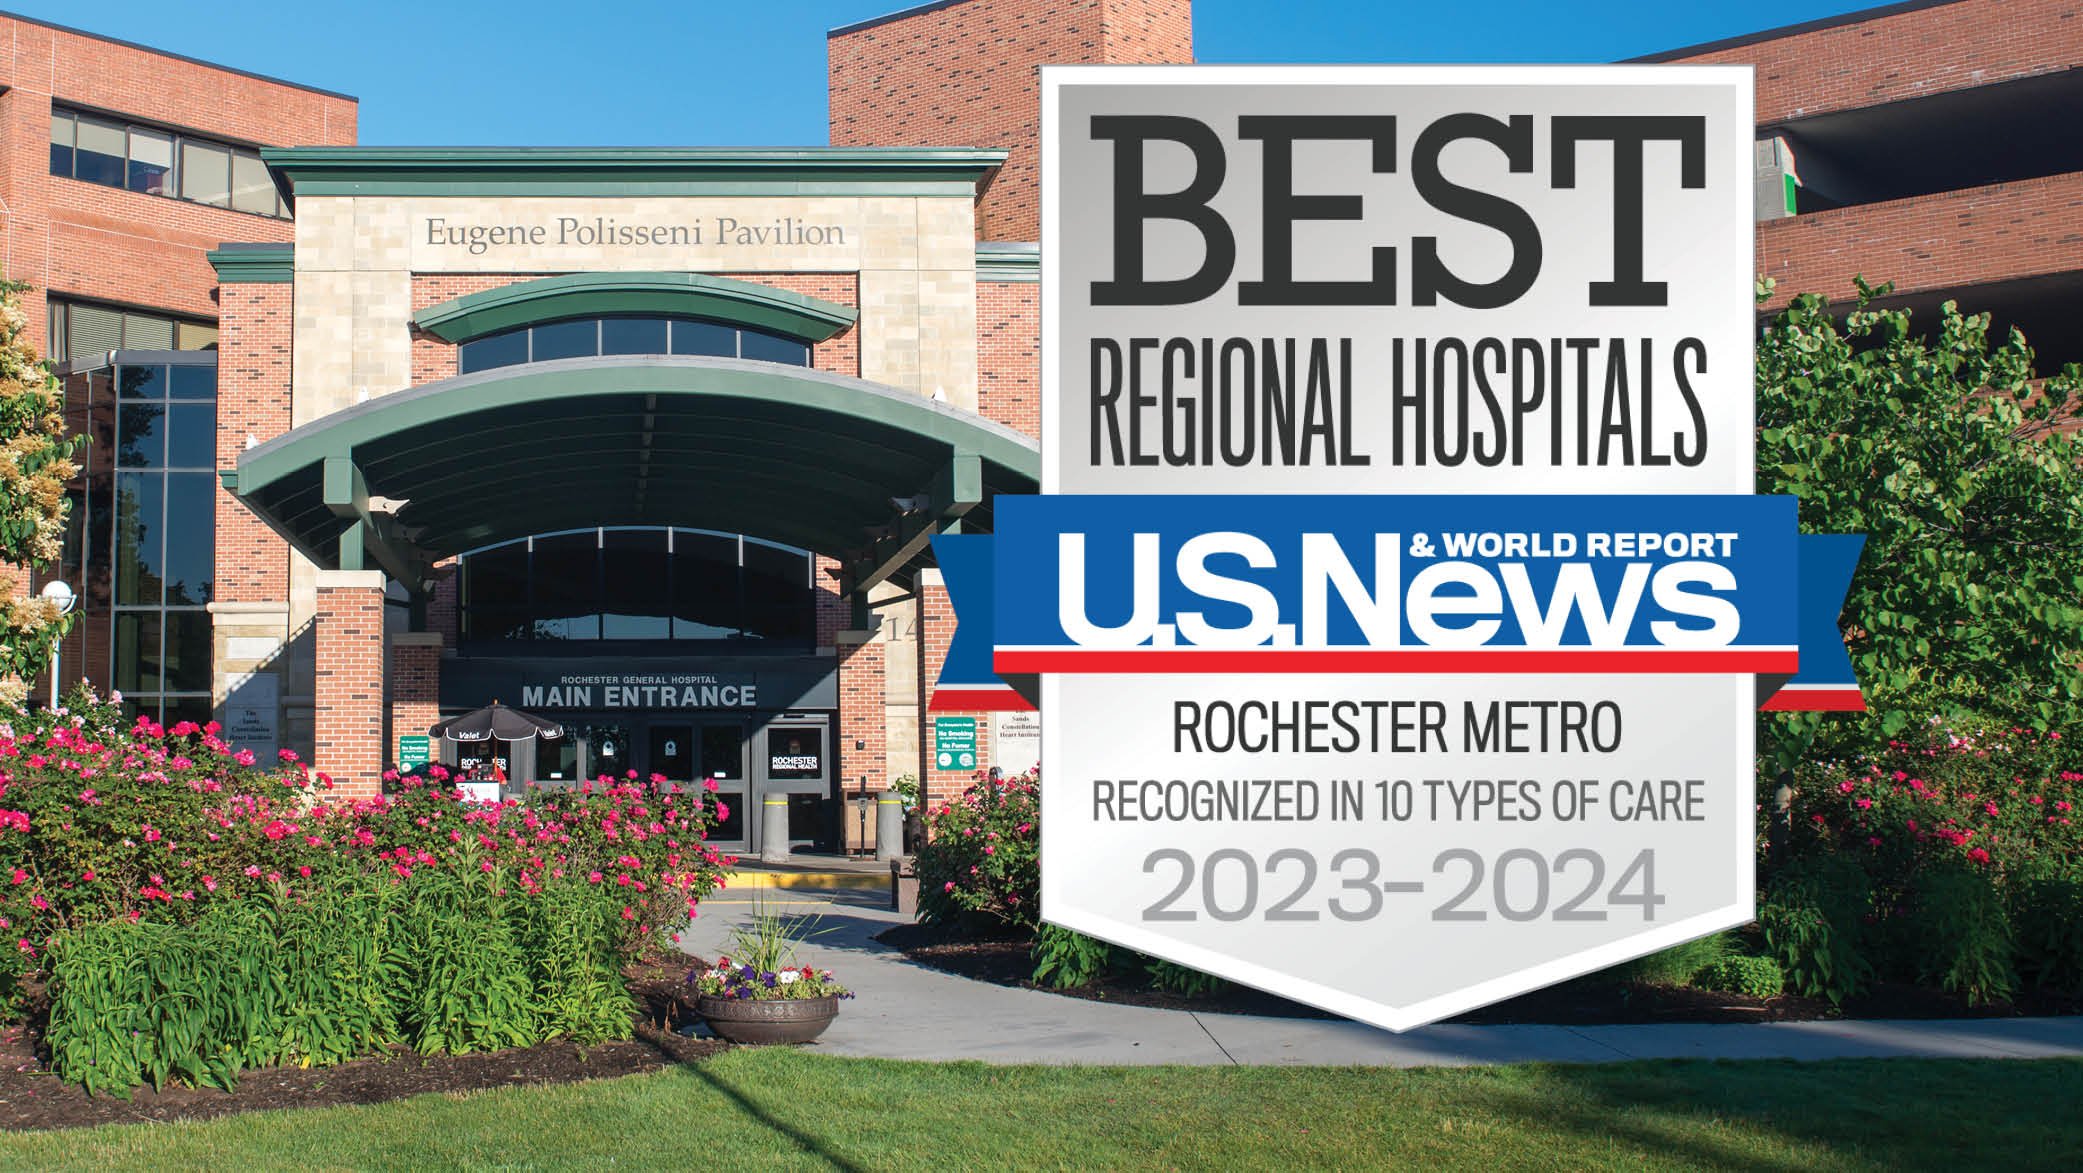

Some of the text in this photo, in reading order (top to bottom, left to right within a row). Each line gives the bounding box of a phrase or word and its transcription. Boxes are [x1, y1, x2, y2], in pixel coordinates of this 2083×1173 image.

[425, 216, 845, 255] Eugene Polisseni Pavilion
[561, 675, 718, 685] ROCHESTER GENERAL HOSPITAL
[522, 685, 757, 707] MAIN ENTRANCE
[459, 731, 480, 739] Valet
[948, 730, 974, 738] Smoking
[772, 756, 818, 765] ROCHESTER
